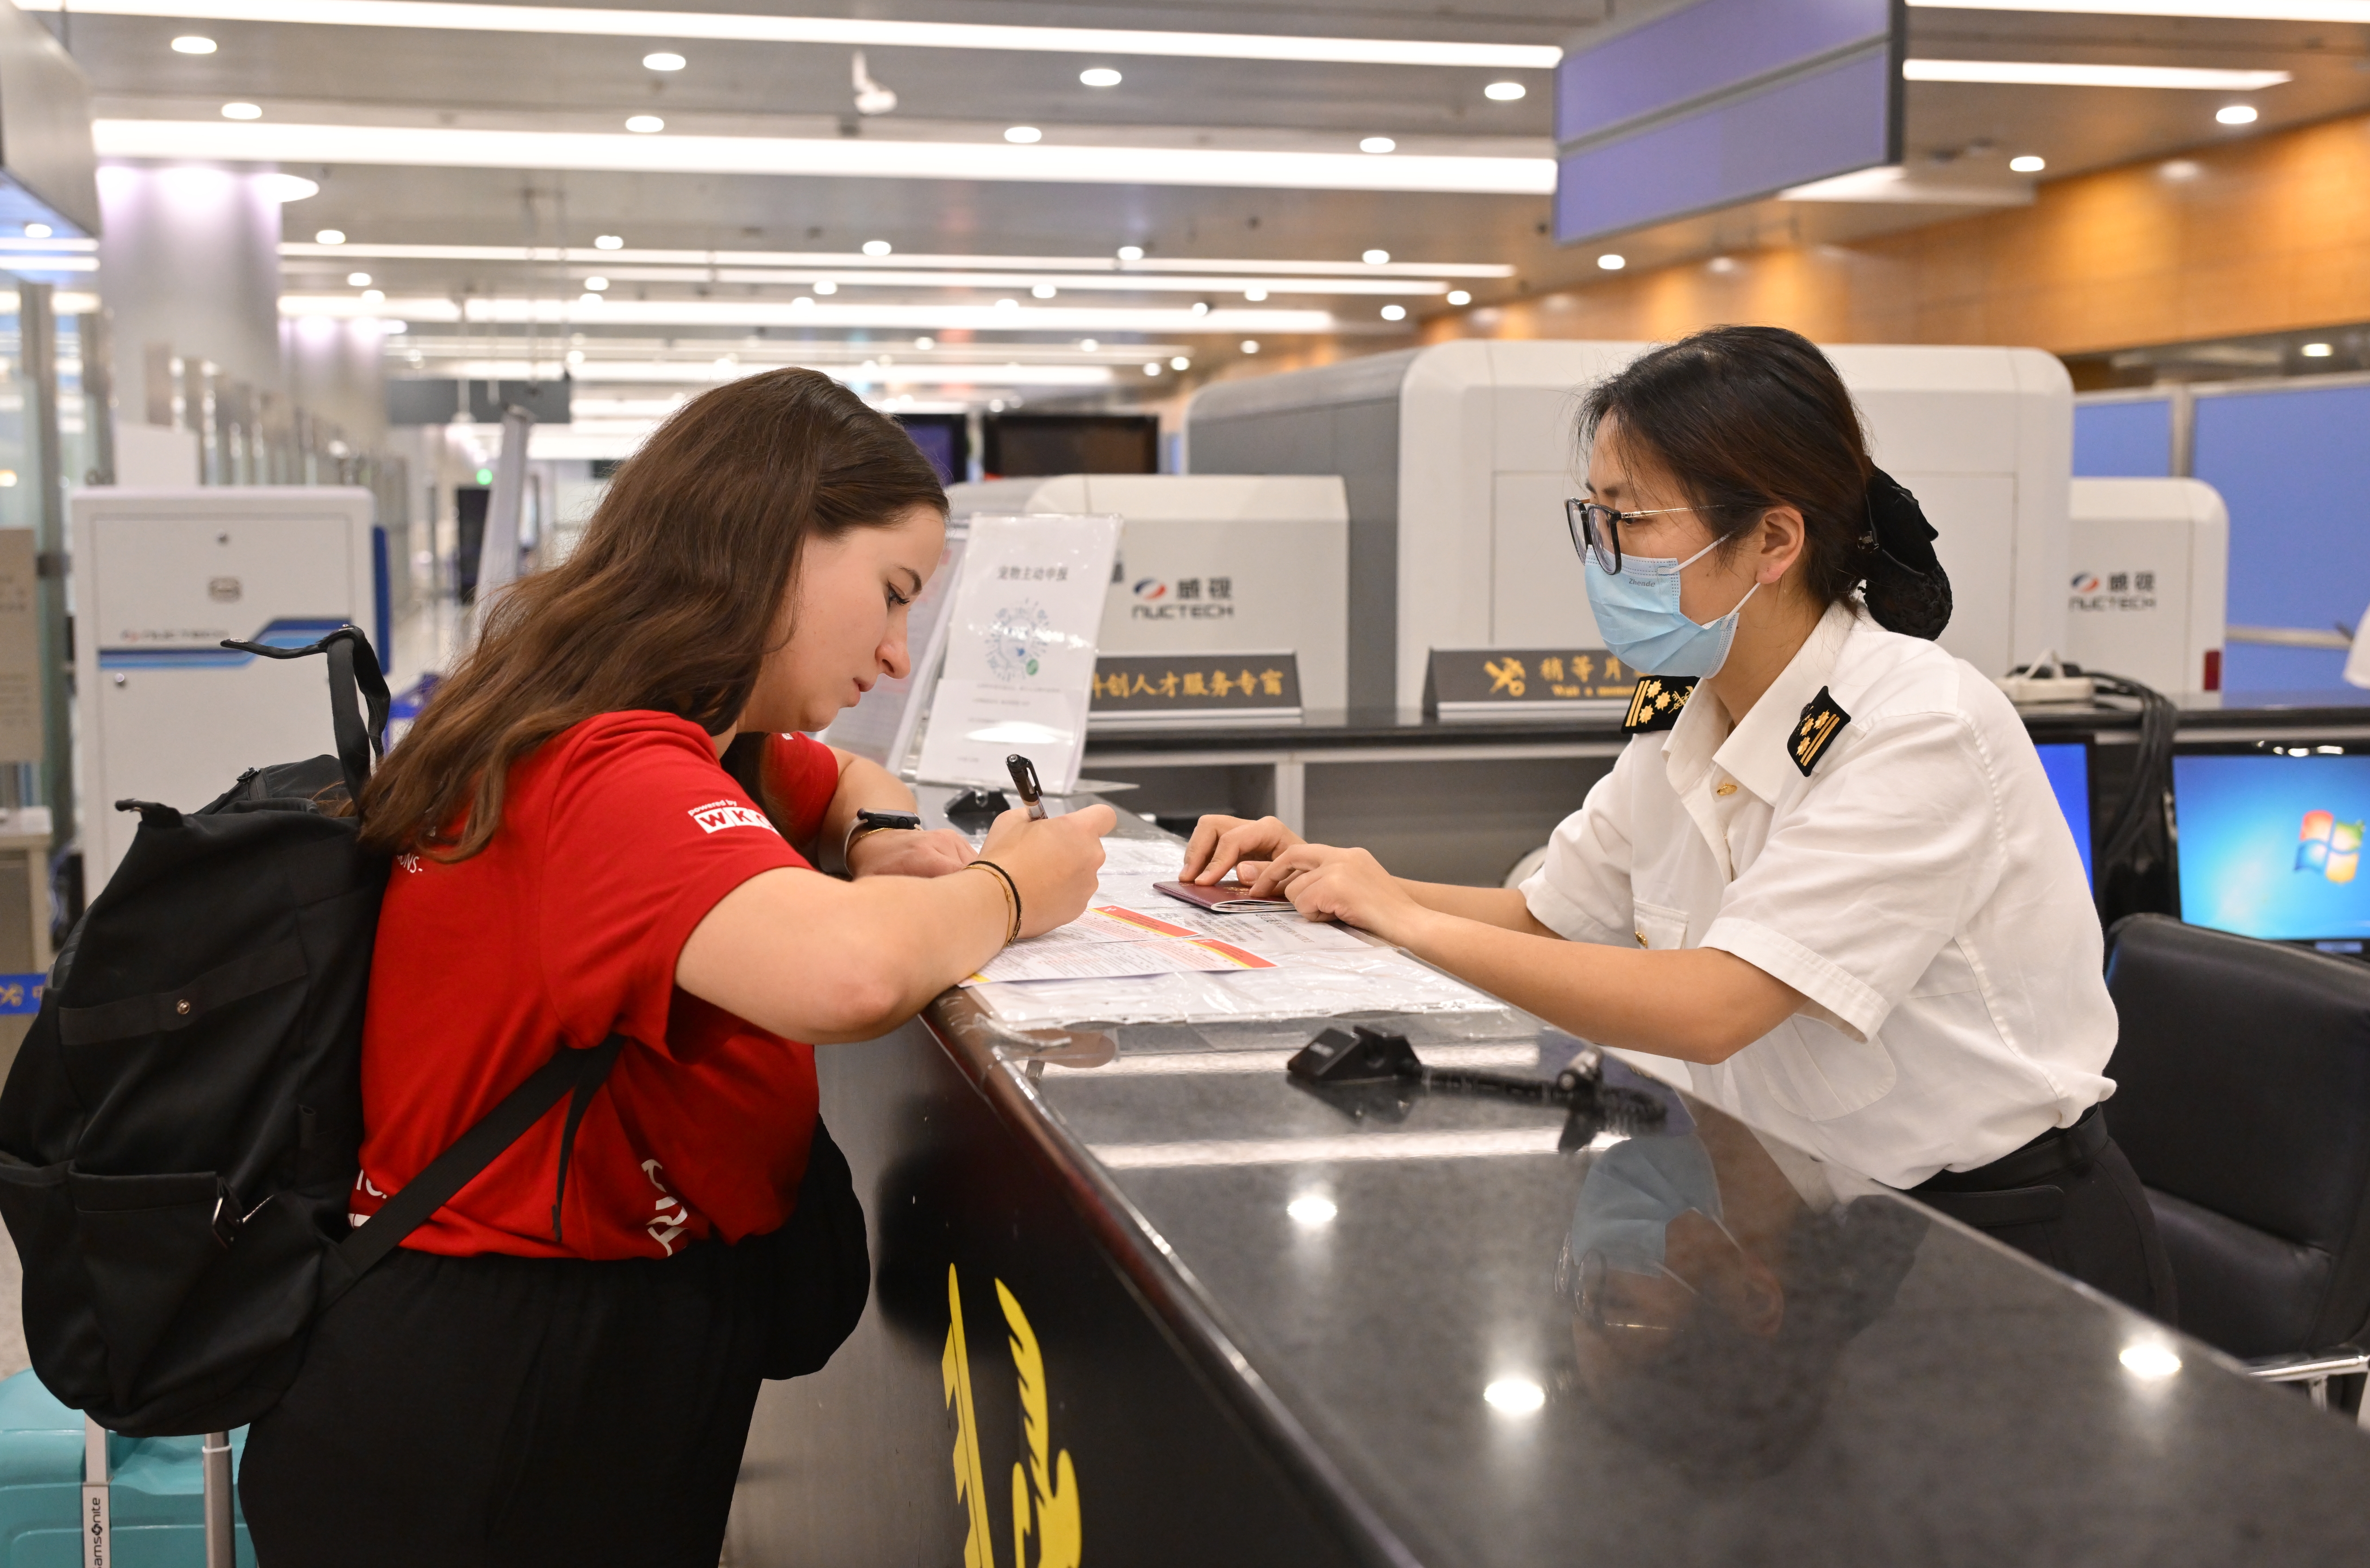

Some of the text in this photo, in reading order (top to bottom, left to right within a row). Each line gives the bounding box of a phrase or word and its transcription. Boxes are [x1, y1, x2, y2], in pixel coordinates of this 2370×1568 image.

[1628, 578, 1656, 587] Zhende
[1132, 604, 1234, 619] NUCTECH
[1540, 655, 1647, 682] 稍等片
[688, 800, 726, 816] powered
[91, 1497, 103, 1568] amsonite
